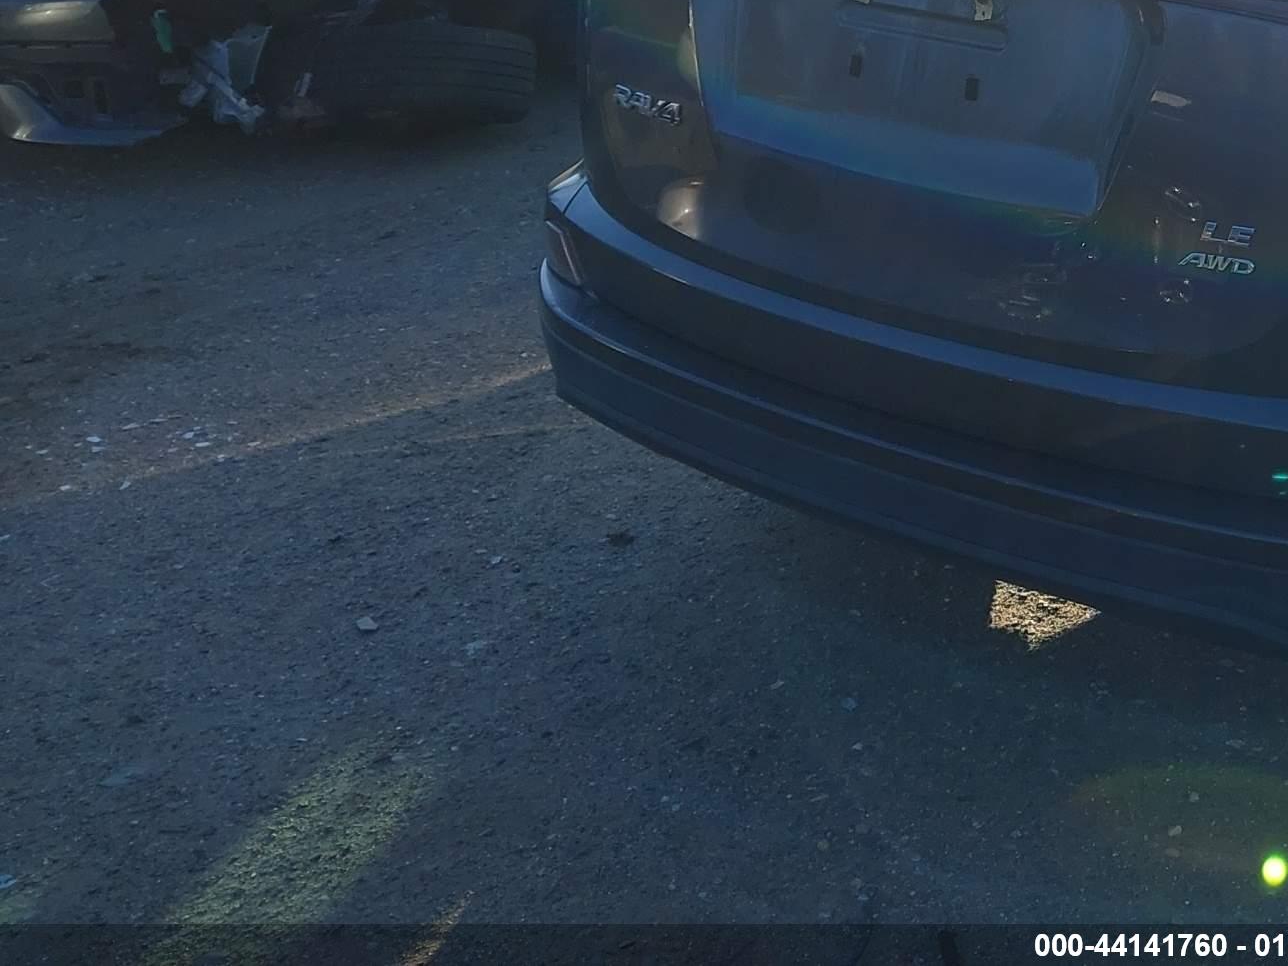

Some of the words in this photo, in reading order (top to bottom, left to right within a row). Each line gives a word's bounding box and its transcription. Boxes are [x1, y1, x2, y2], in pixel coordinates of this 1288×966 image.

[614, 83, 682, 126] RAV4
[1199, 221, 1256, 248] LE
[1178, 252, 1256, 275] AWD
